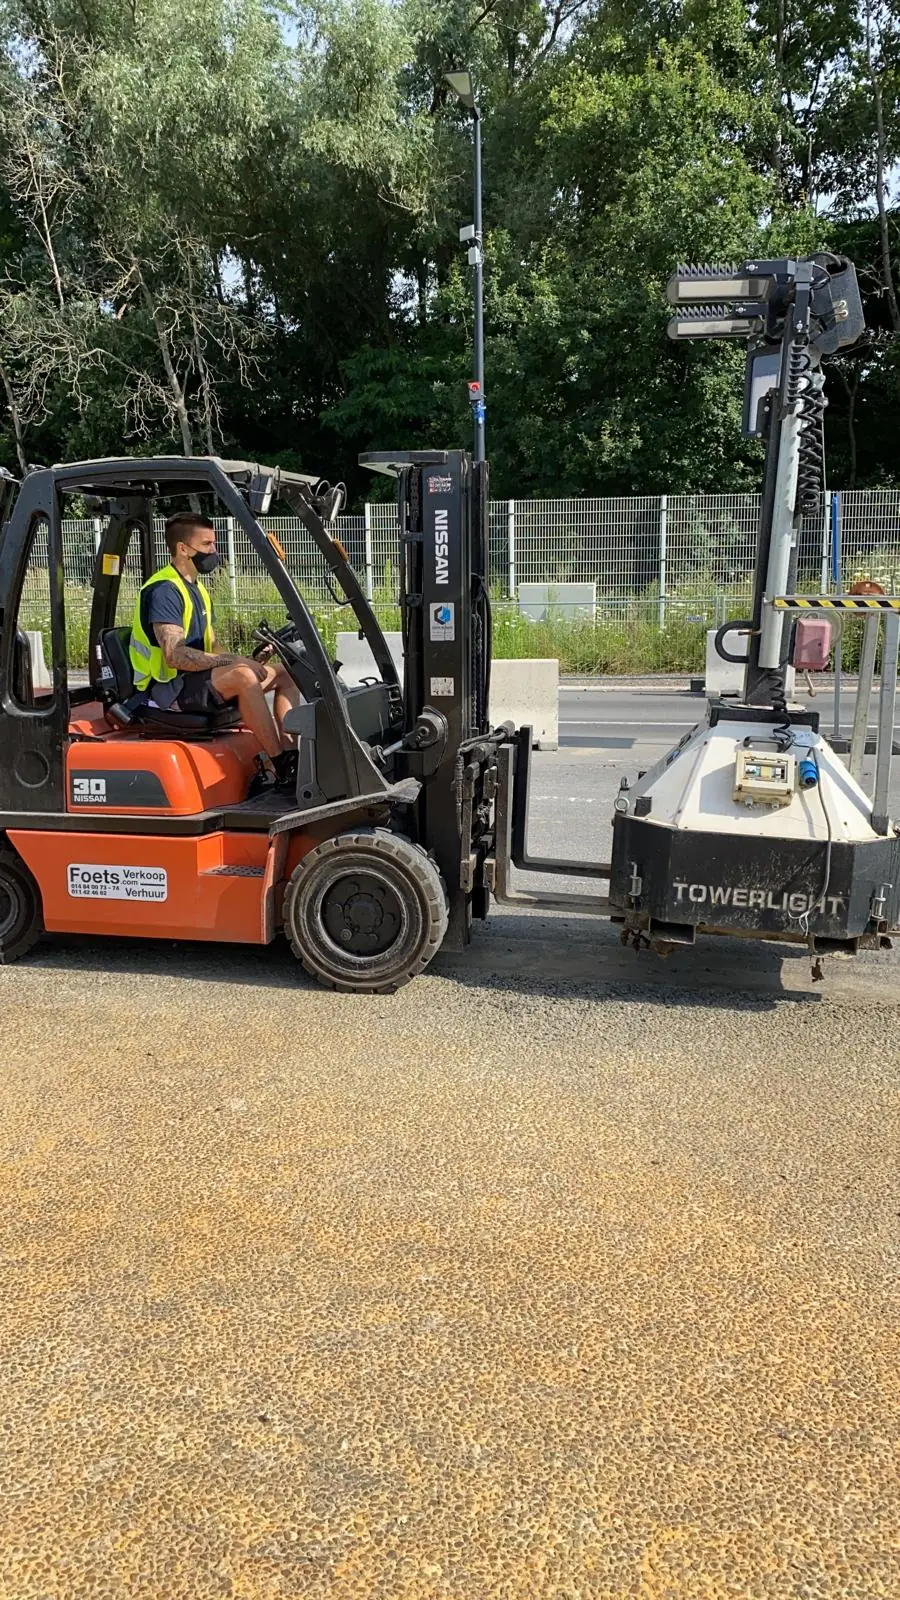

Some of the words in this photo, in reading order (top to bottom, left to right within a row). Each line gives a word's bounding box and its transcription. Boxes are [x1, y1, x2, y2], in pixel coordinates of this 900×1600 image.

[434, 509, 449, 584] NISSAN
[73, 778, 106, 795] 30
[70, 867, 120, 884] Foets
[123, 869, 166, 882] Verkoop
[125, 887, 166, 898] Verhuur
[673, 882, 844, 915] TOWERLIGHT
